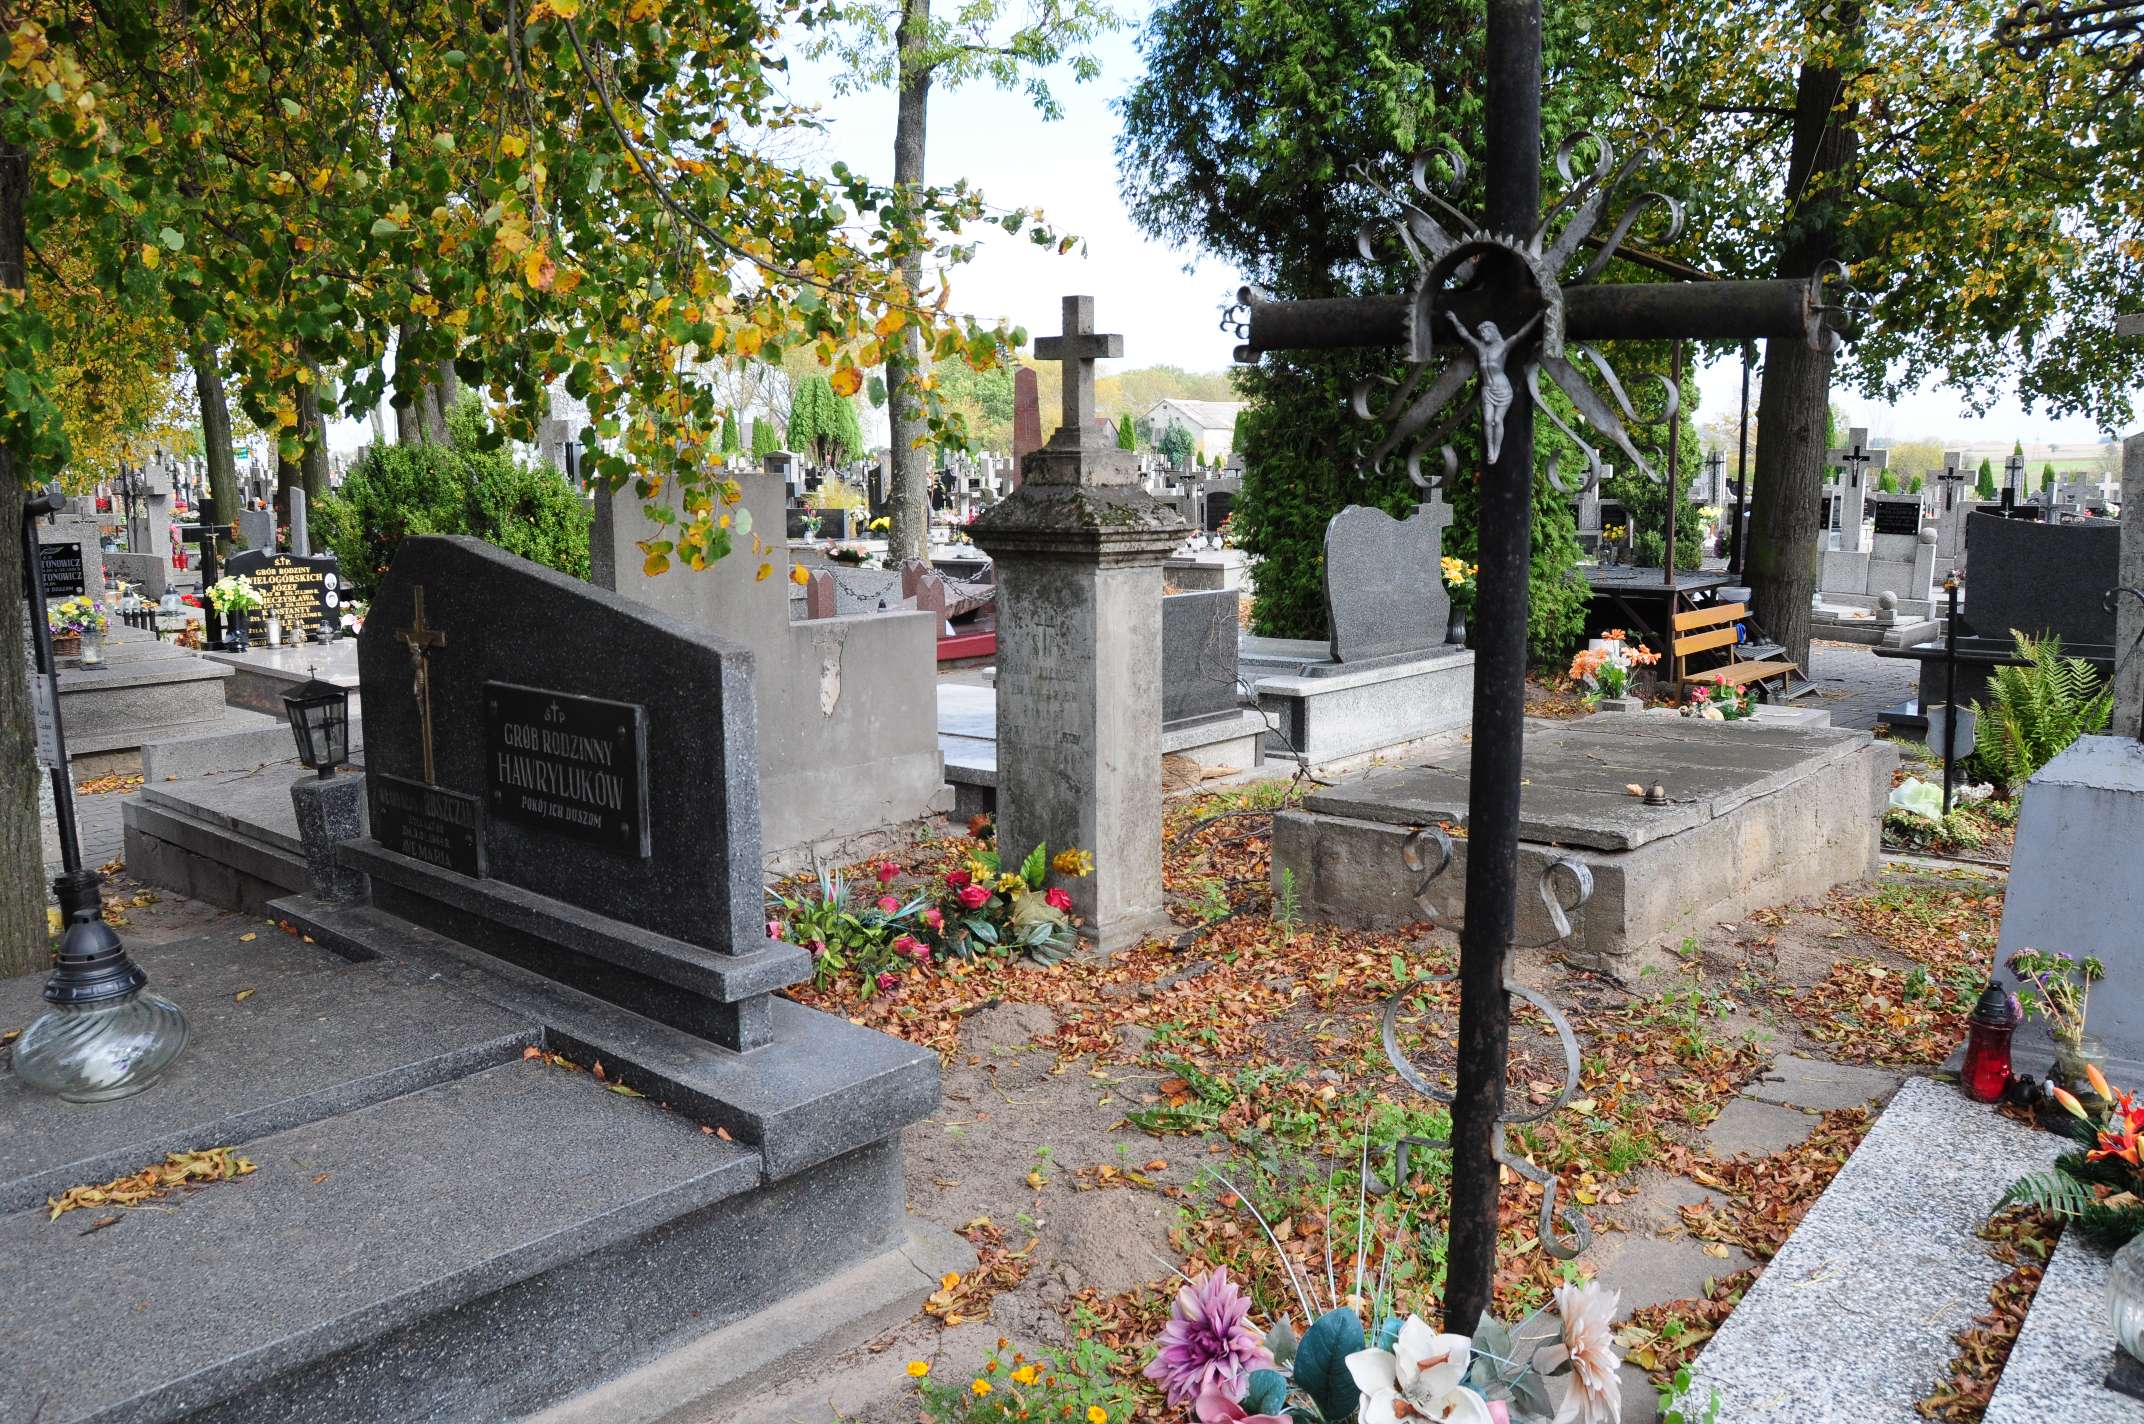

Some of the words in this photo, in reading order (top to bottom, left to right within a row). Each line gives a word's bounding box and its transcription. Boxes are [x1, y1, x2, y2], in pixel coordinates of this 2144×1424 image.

[41, 559, 81, 568] TONOWICZ
[256, 568, 276, 576] GRÓB
[279, 567, 311, 575] RODZINY
[42, 572, 82, 581] TONOWICZ
[272, 584, 298, 592] JÓZEF
[263, 595, 315, 604] IECZYSŁAWA
[262, 607, 310, 616] KNSTANTY
[504, 723, 539, 751] GRÓB
[542, 729, 613, 766] RODZINNY
[498, 752, 624, 810] HAWRYLUKÓW
[521, 796, 547, 817] POKÓJ
[550, 803, 563, 818] ICH
[566, 807, 602, 828] DUSZOM
